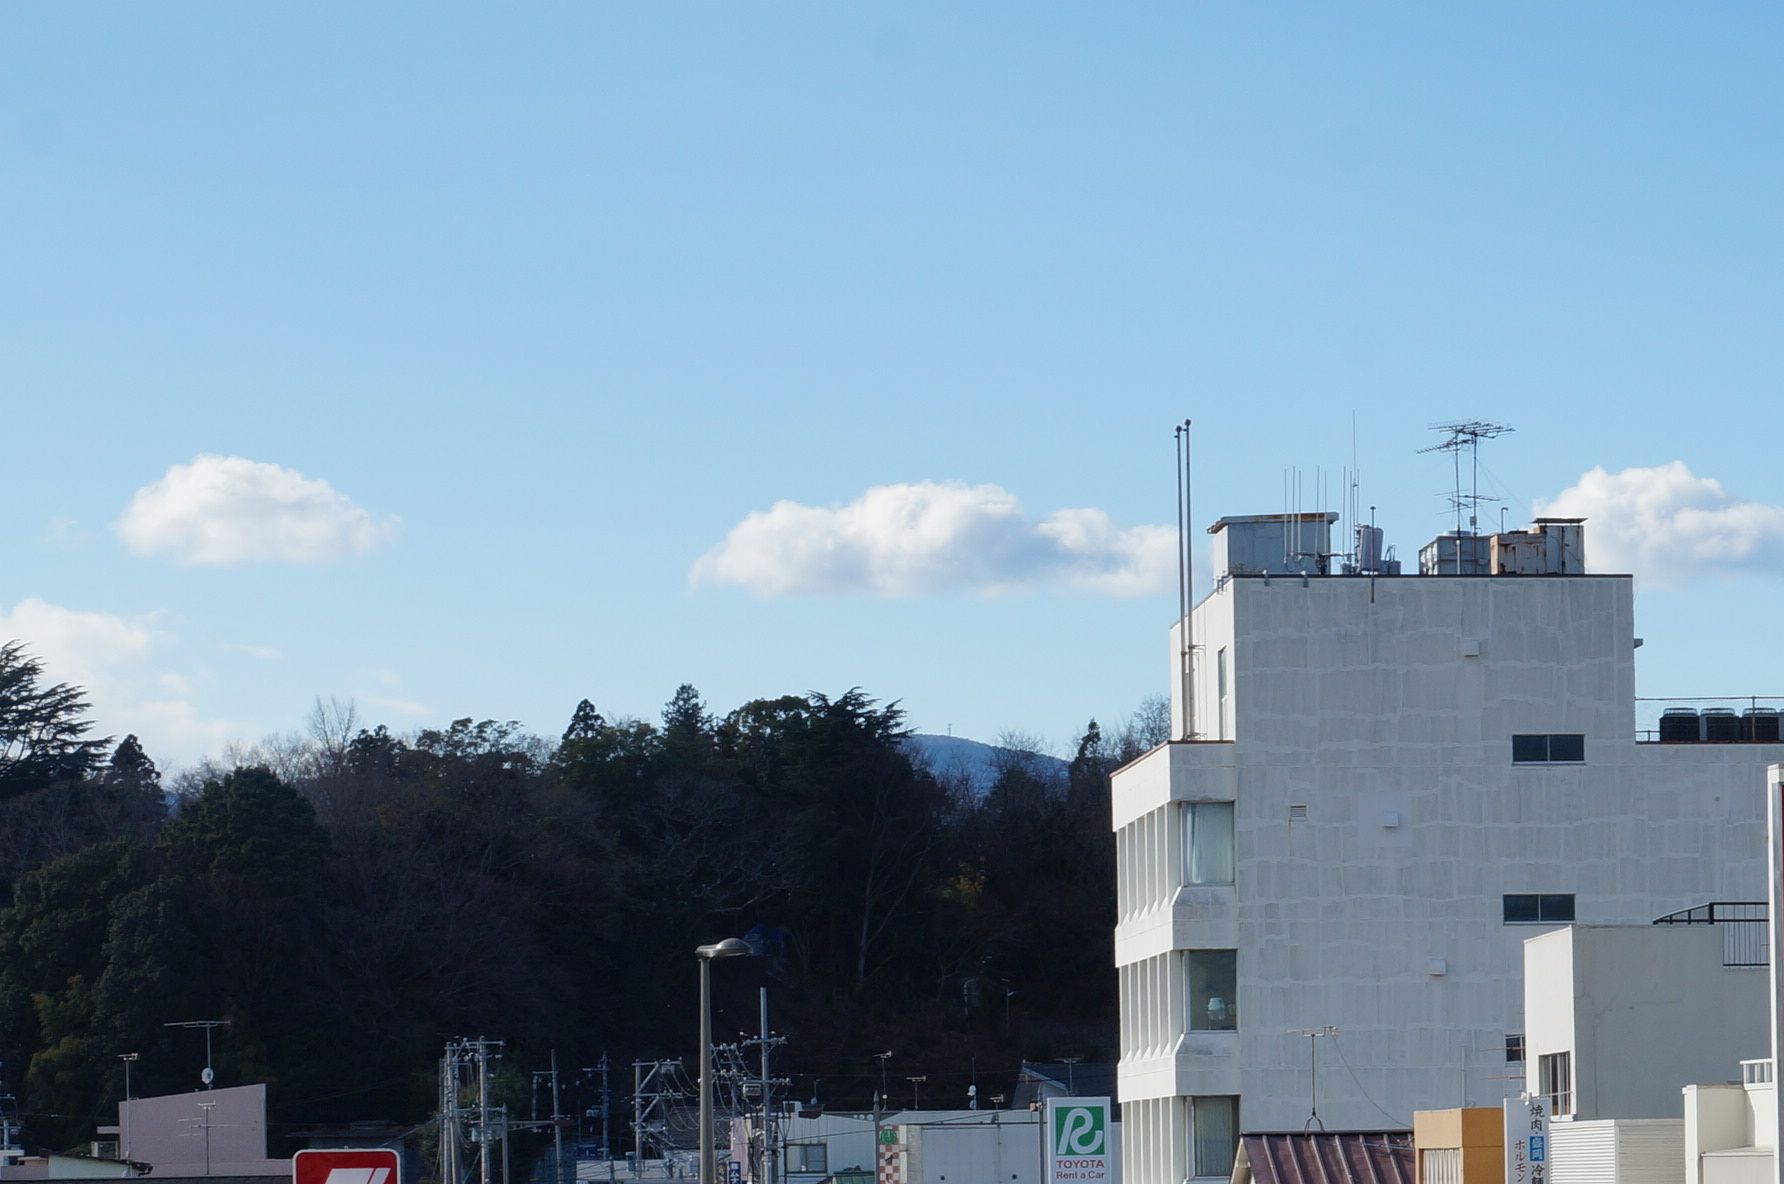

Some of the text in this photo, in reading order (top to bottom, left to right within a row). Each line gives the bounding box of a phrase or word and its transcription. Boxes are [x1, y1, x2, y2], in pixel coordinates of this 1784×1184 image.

[1056, 1159, 1104, 1168] TOYOTA
[1056, 1171, 1077, 1179] Rent
[1088, 1171, 1104, 1179] Car
